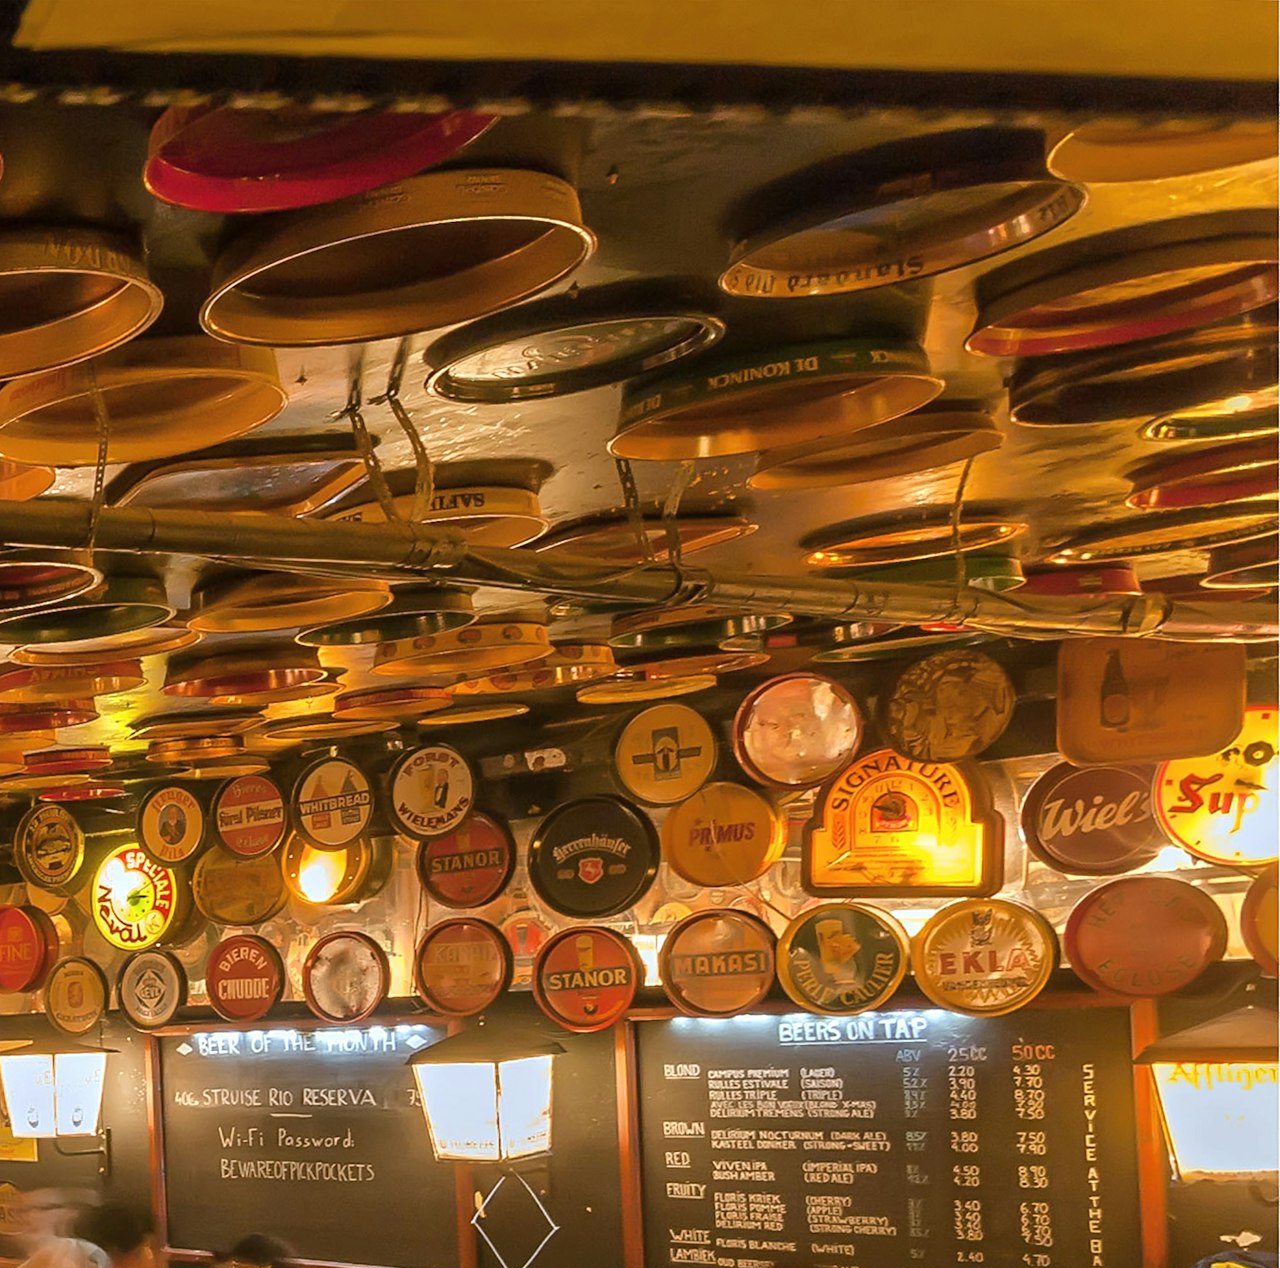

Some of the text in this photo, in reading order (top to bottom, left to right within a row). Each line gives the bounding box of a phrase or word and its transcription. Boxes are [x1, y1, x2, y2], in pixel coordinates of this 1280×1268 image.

[707, 356, 819, 389] DE KONINCK
[403, 750, 460, 779] FORST
[299, 791, 371, 816] WHITBREAD
[397, 795, 470, 829] WIELEMANS
[1042, 792, 1155, 842] Wiel's
[689, 821, 756, 850] PRIMUS
[431, 849, 501, 873] STANOR
[218, 946, 268, 974] BIEREN
[674, 952, 768, 975] MAKASI
[939, 946, 1032, 977] EKLA
[548, 969, 629, 991] STANOR
[778, 1017, 928, 1043] BEERS ON TAP
[198, 1029, 397, 1056] BEER OF THE MONTH
[895, 1049, 921, 1062] ABV
[663, 1063, 701, 1078] BLOND
[707, 1069, 745, 1079] CAMPUS
[948, 1065, 975, 1077] 2.20
[1012, 1064, 1041, 1076] 4.30
[949, 1077, 976, 1090] 3.90
[202, 1088, 377, 1107] STRUISE RIO RESERVA
[1082, 1063, 1098, 1163] SERVICE
[218, 1127, 355, 1149] Wi-Fi Password:
[663, 1121, 706, 1136] BROWN
[758, 1130, 824, 1141] NOCTURNUM
[951, 1131, 978, 1143] 3.80
[710, 1140, 755, 1149] KASTEEL
[664, 1151, 691, 1166] RED
[712, 1160, 752, 1171] VIVEN
[752, 1160, 768, 1171] IPA
[220, 1160, 375, 1183] BEWAREOFPICKPOCKETS
[739, 1171, 776, 1182] AMBER
[666, 1181, 707, 1197] FRUITY
[668, 1228, 711, 1242] WHITE
[669, 1247, 717, 1262] LAMBIEK
